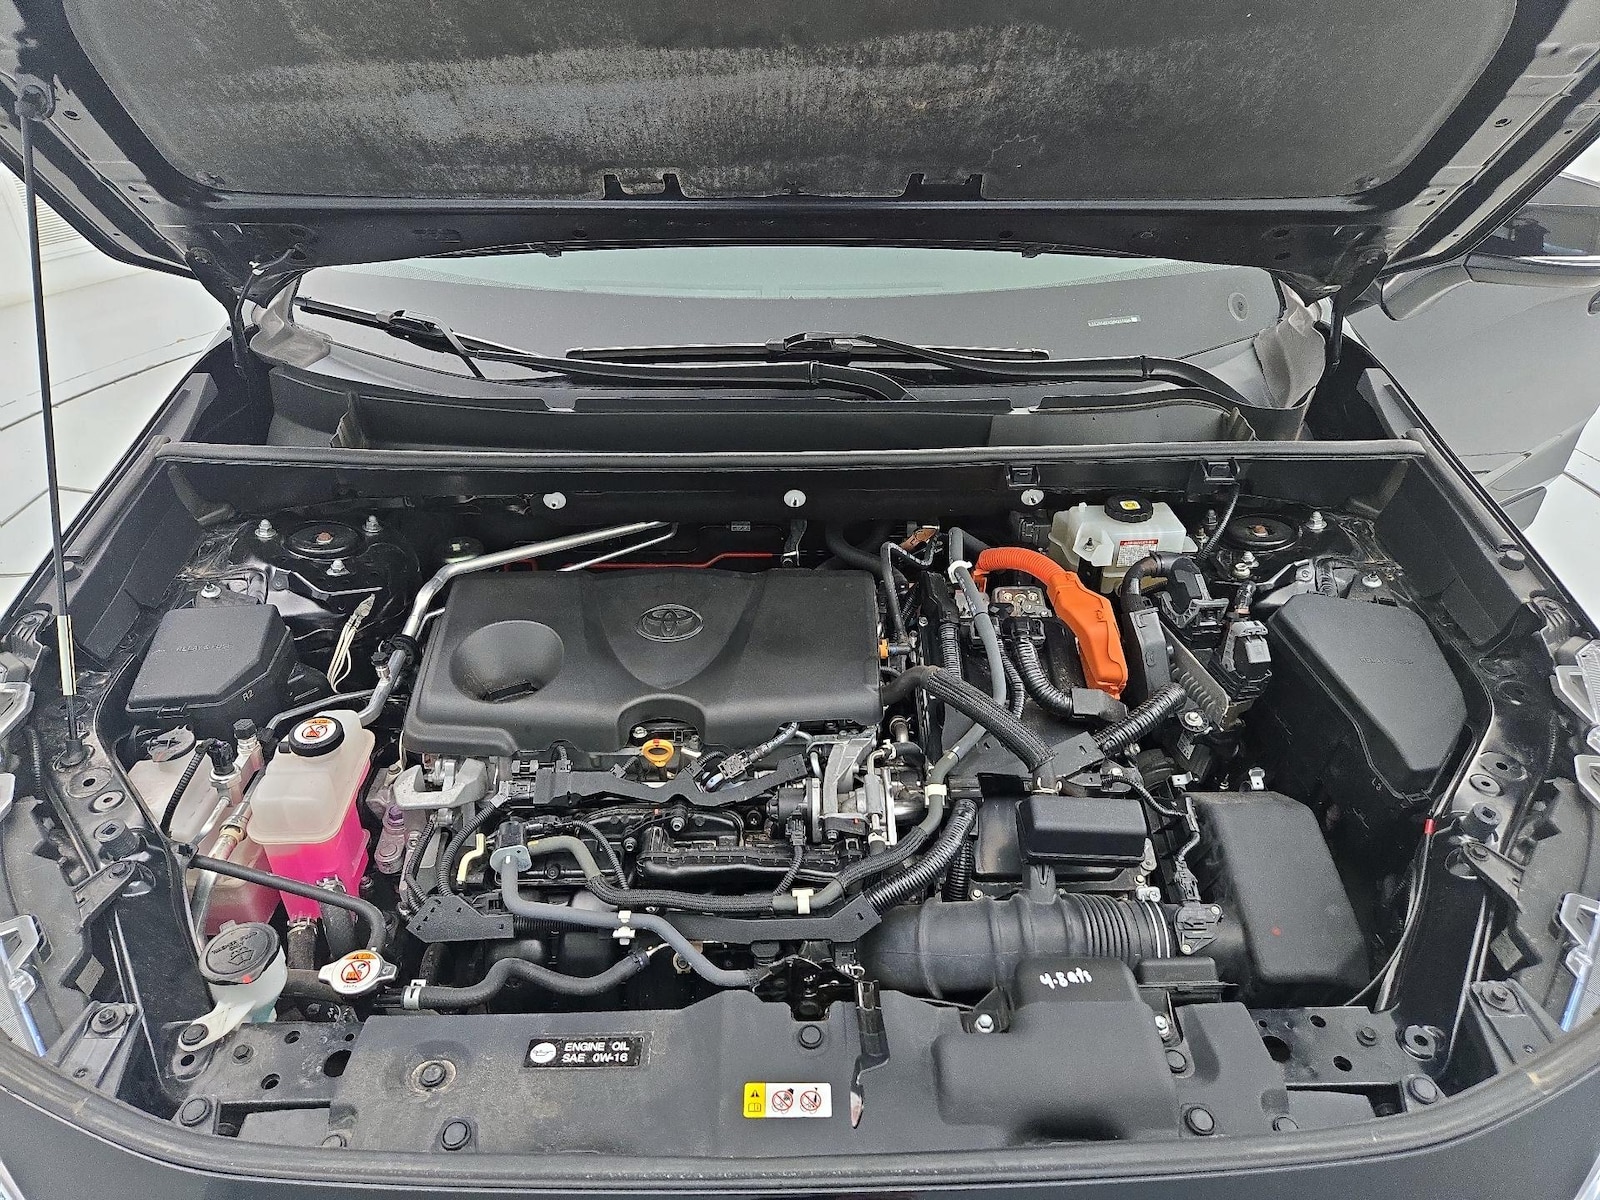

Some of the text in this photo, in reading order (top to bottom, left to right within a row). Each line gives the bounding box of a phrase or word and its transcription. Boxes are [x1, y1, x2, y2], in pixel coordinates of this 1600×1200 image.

[242, 689, 254, 701] R2
[564, 1041, 630, 1052] ENGINE OIL
[562, 1052, 628, 1063] SAE 0W-16
